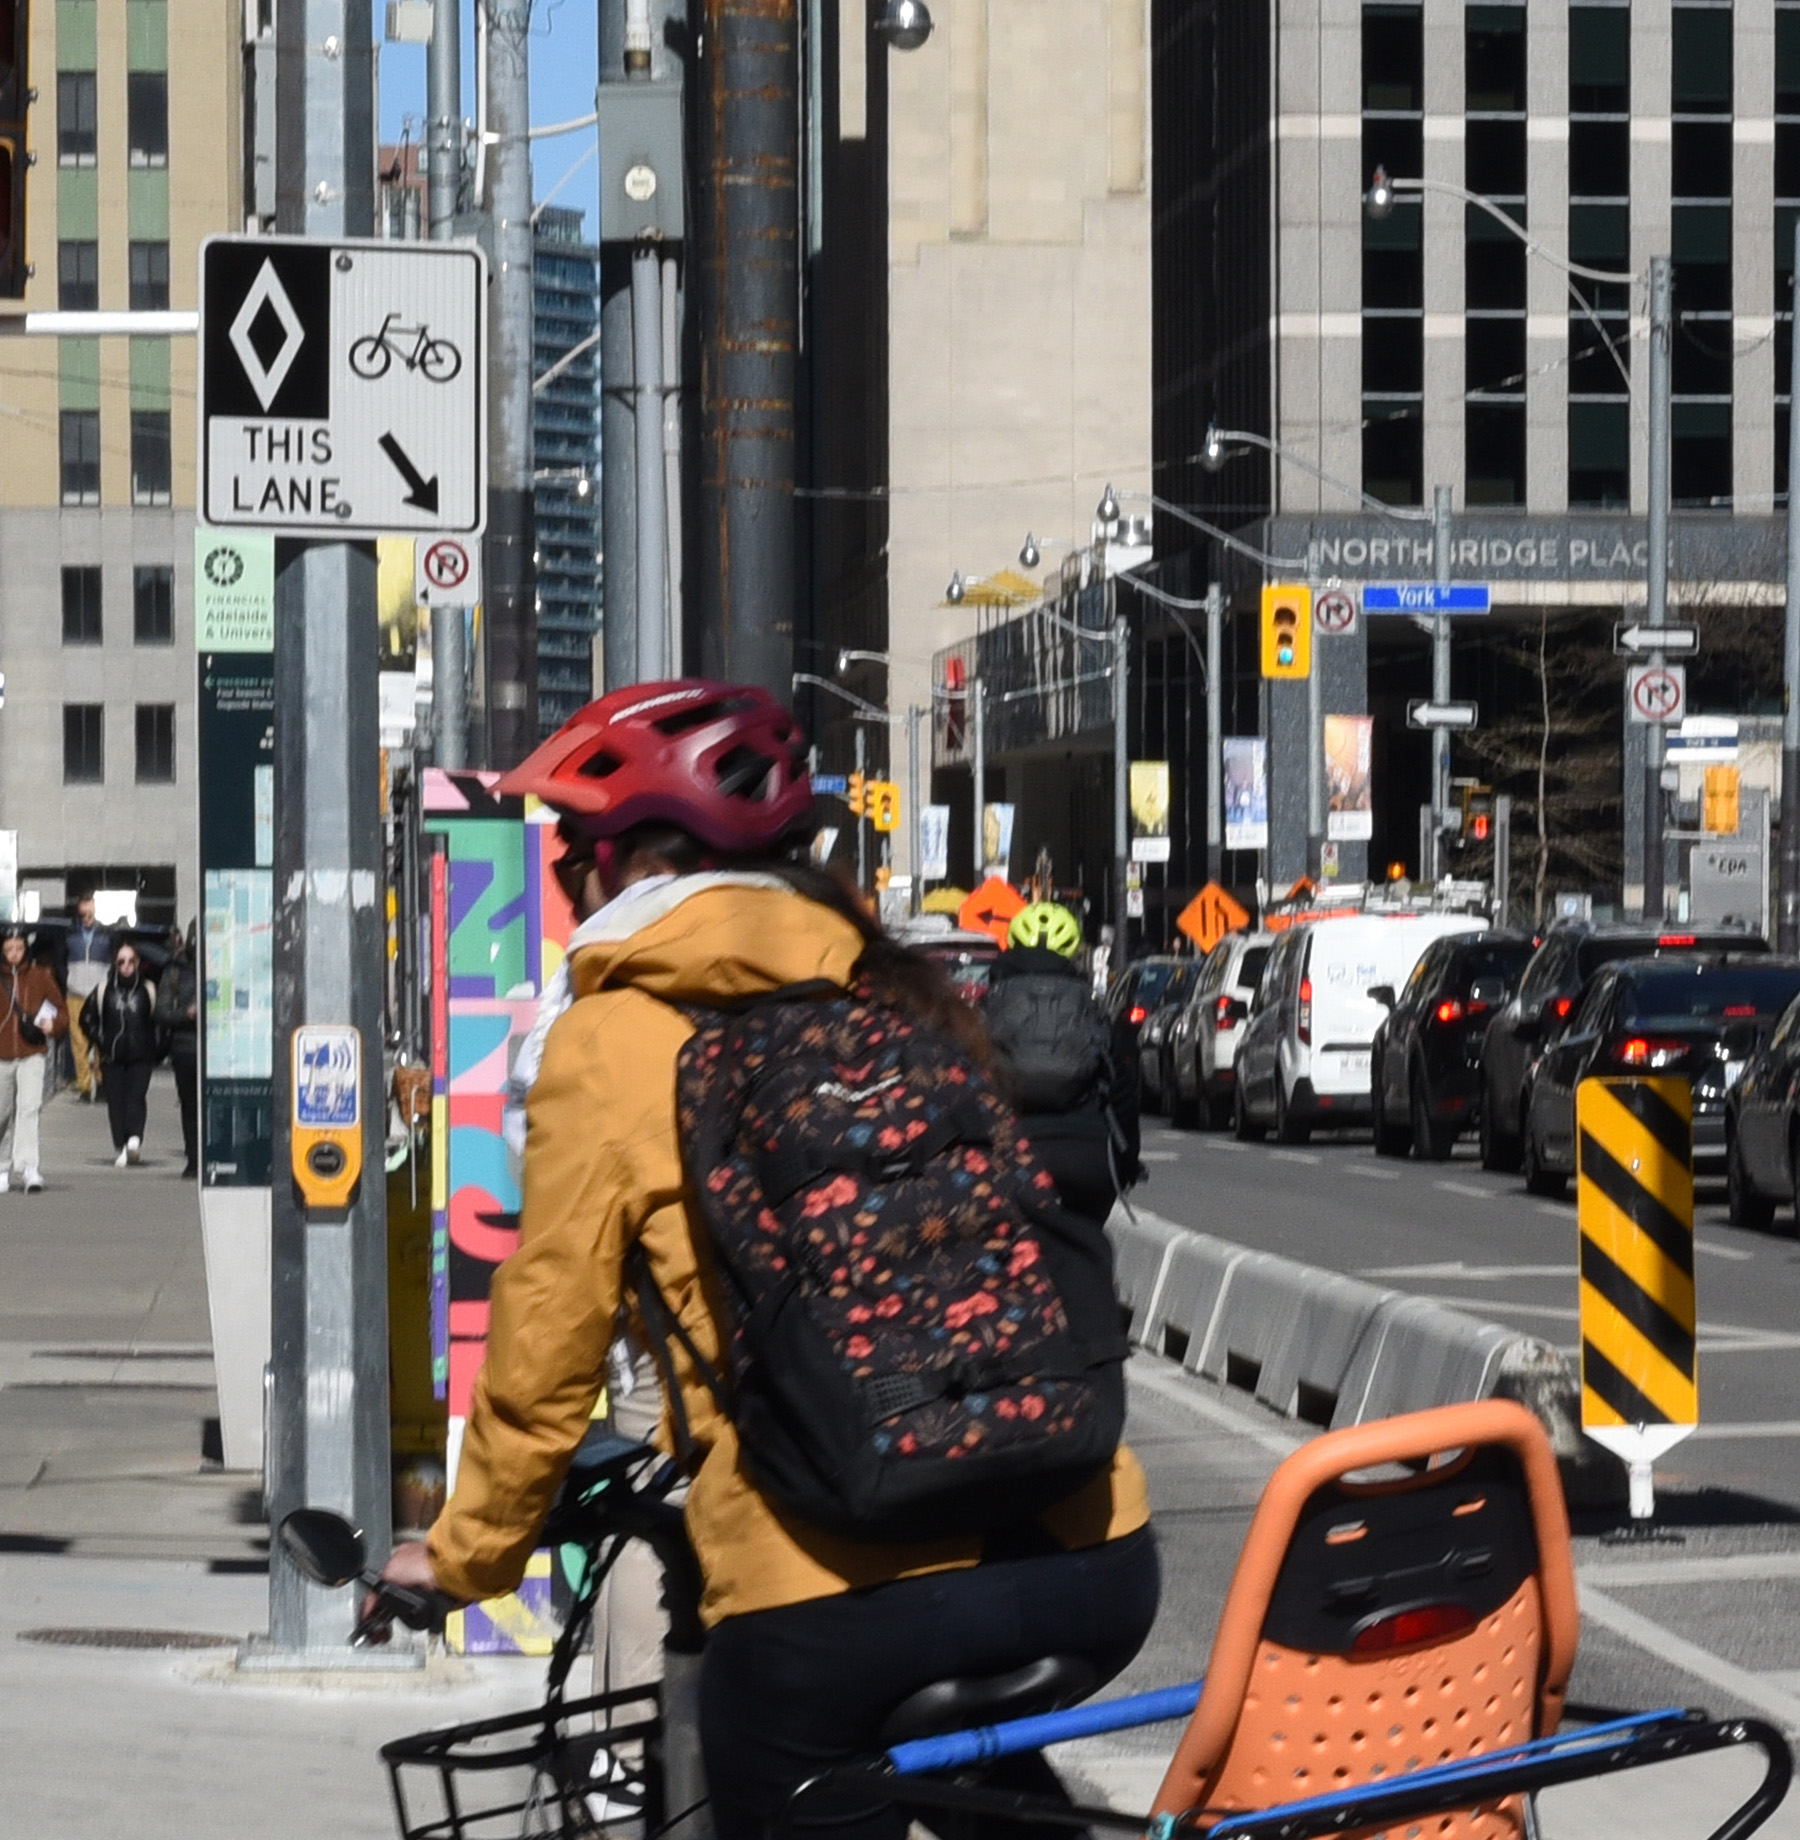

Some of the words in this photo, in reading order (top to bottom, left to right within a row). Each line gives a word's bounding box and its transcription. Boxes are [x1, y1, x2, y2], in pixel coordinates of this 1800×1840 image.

[243, 426, 332, 464] THIS
[233, 474, 341, 513] LANE
[1397, 585, 1434, 607] York
[206, 608, 268, 623] Adelaide
